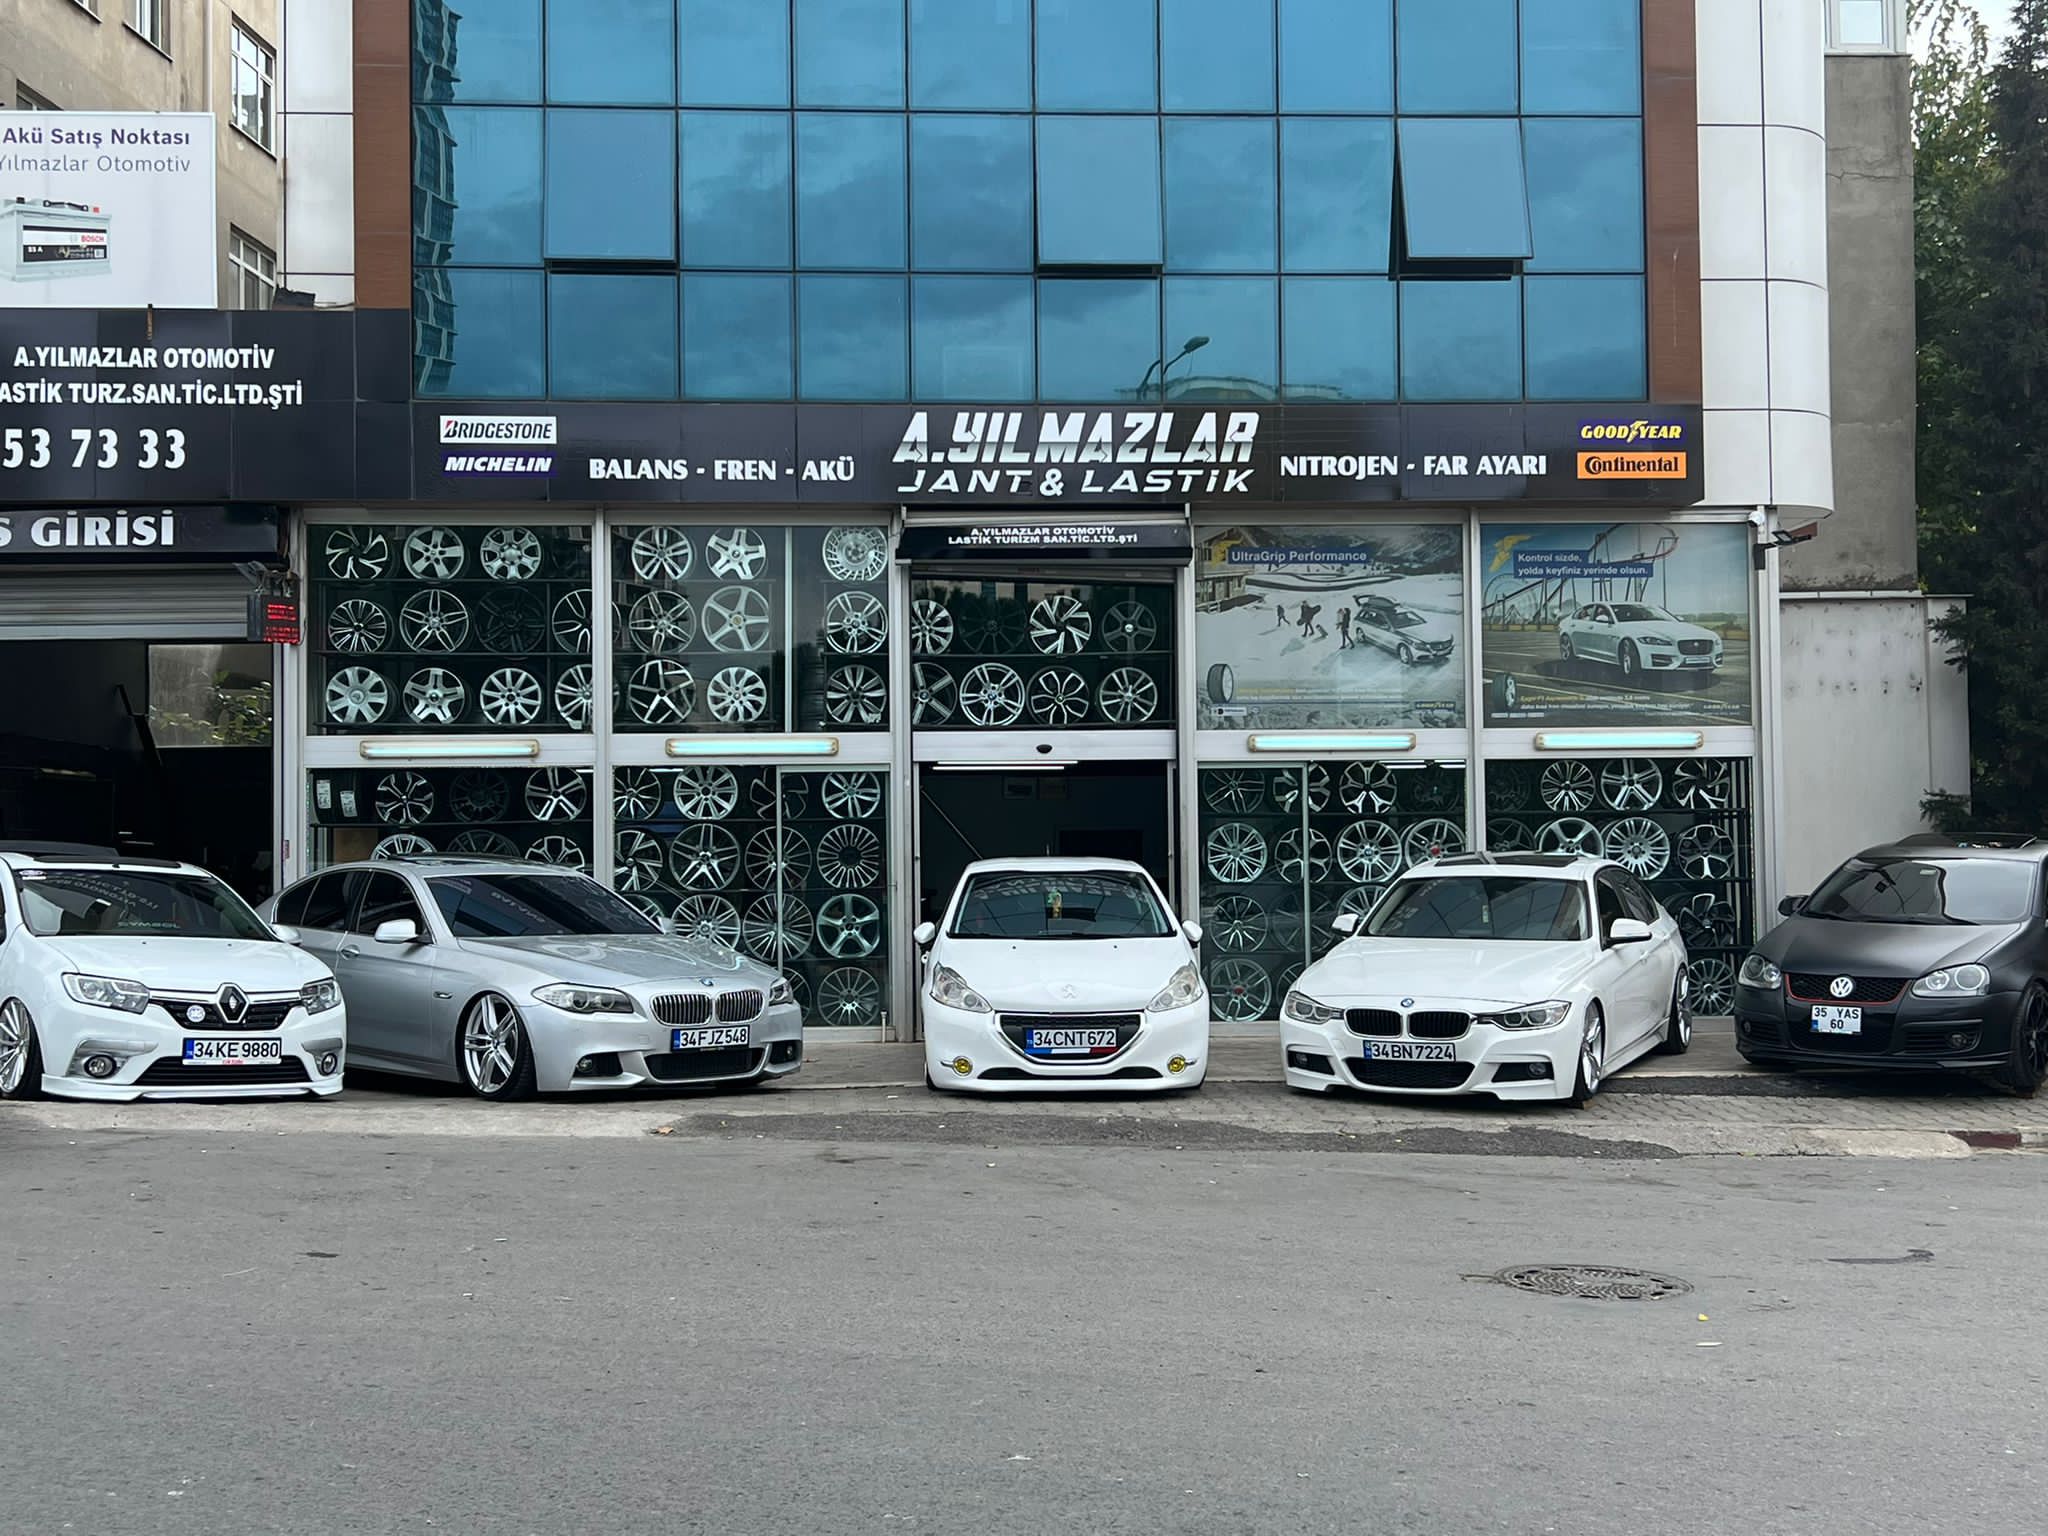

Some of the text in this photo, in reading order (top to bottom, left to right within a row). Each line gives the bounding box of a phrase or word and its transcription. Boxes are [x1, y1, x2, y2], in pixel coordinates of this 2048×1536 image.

[2, 127, 190, 148] Akü Satış Noktası
[0, 155, 191, 172] Yılmazlar Otomotiv
[14, 343, 275, 369] A.YILMAZLAR OTOMOTİV
[68, 379, 302, 410] TURZ.SAN.TİC.LTD.ŞTİ
[444, 419, 552, 439] BRIDGESTONE
[892, 411, 1260, 464] A.YILMAZLAR
[1581, 420, 1682, 443] GOODYEAR
[2, 428, 186, 468] 53 73 33
[445, 456, 552, 472] MICHELIN
[589, 457, 688, 480] BALANS
[714, 459, 776, 481] FREN
[802, 455, 854, 481] AKÜ
[1280, 455, 1398, 481] NITROJEN
[1423, 455, 1468, 475] FAR
[1476, 455, 1547, 475] AYARI
[1585, 456, 1679, 474] Continental
[897, 468, 1255, 496] JANT & LASTİK
[948, 535, 991, 544] LASTİK
[994, 535, 1040, 544] TURİZM
[971, 526, 1115, 537] A.YILMAZLAR OTOMOTİV
[1232, 551, 1367, 564] UltraGrip Performance
[1518, 554, 1552, 562] Kontrol
[1518, 566, 1543, 576] yolda
[1583, 566, 1617, 576] yerinde
[1620, 566, 1648, 575] olsun.
[1814, 1007, 1859, 1019] 35 YAS
[1830, 1019, 1844, 1029] 60
